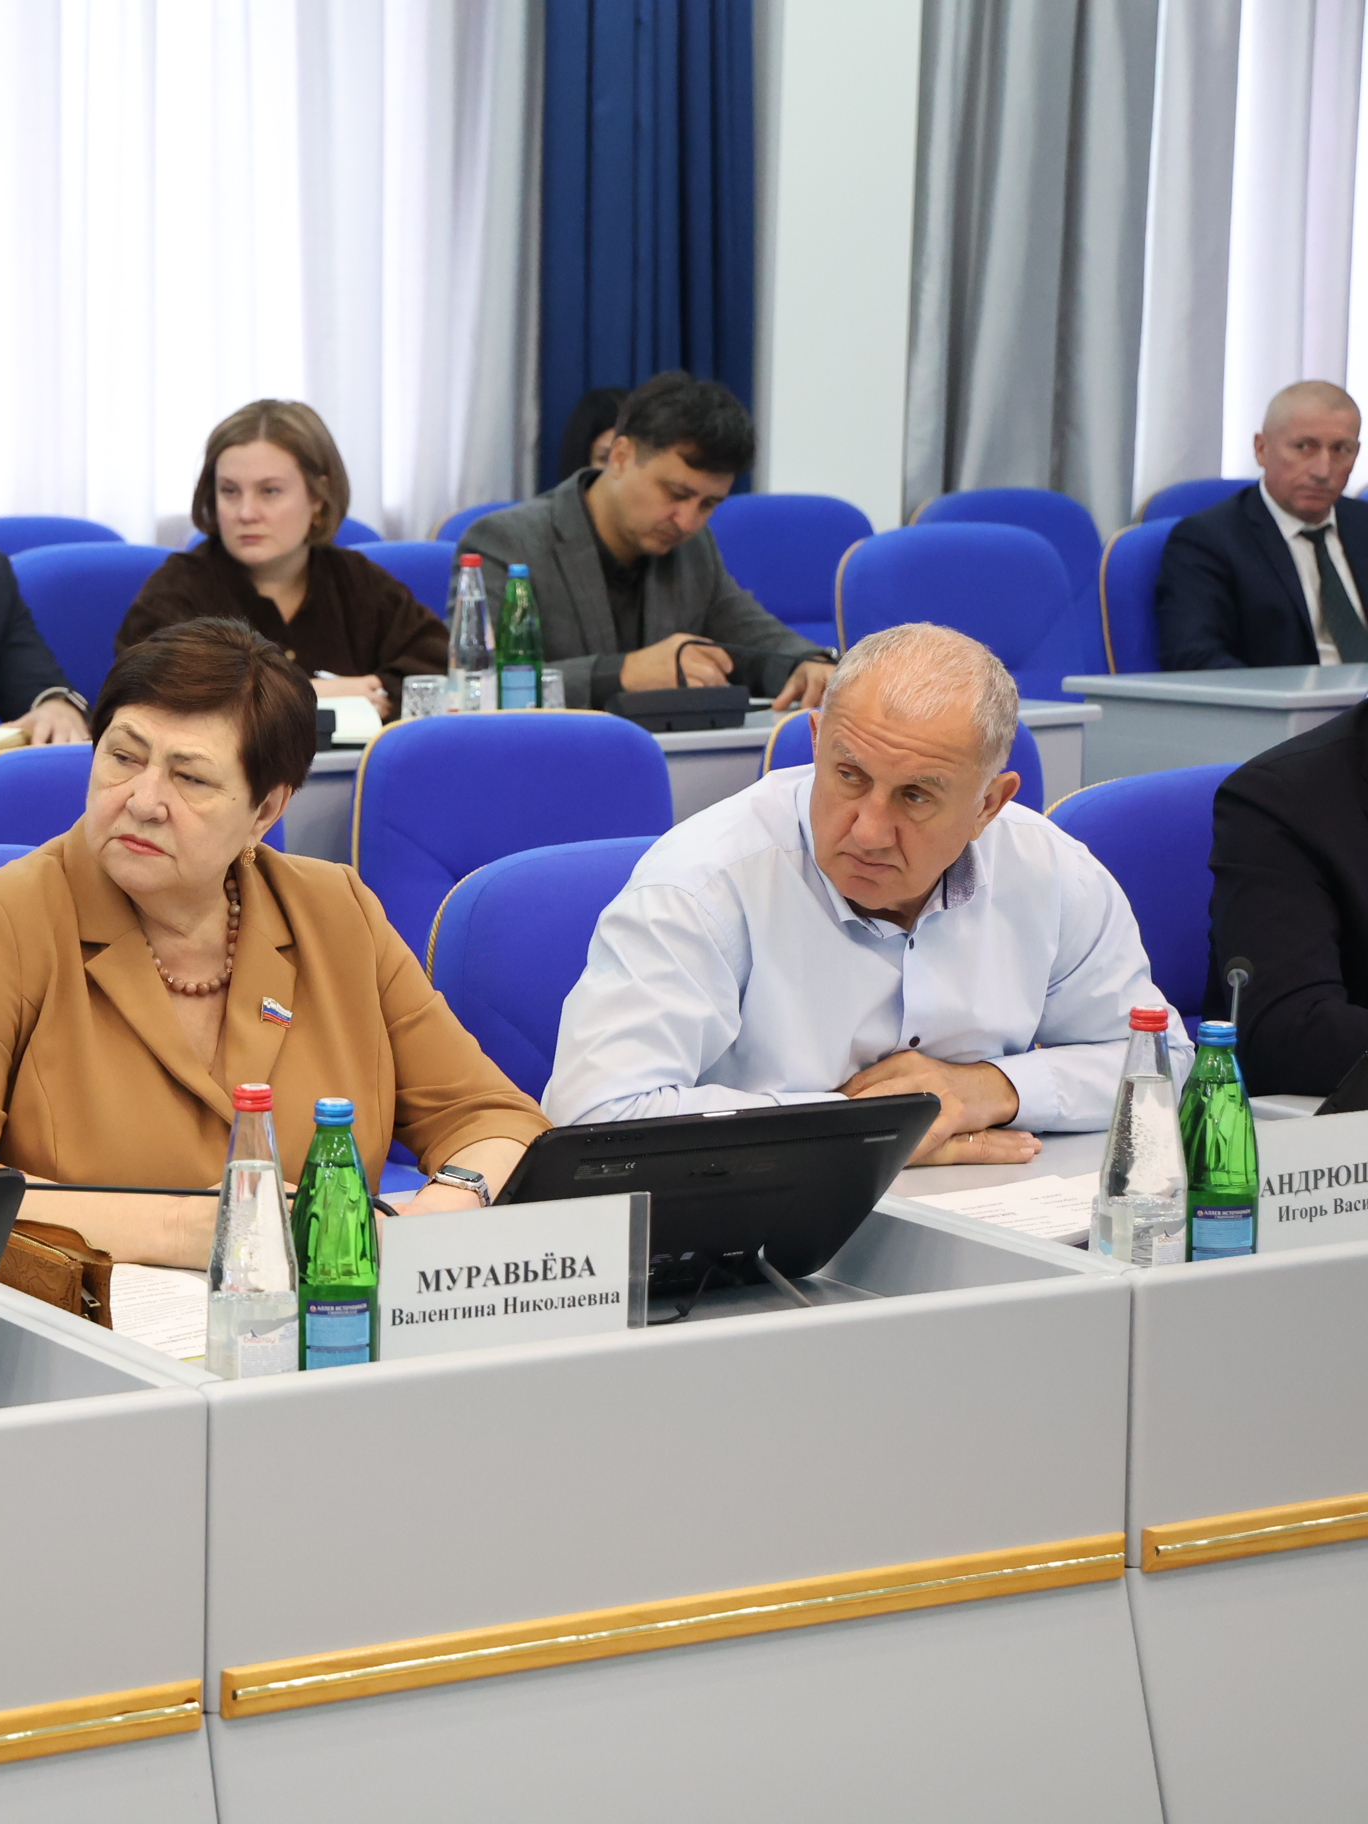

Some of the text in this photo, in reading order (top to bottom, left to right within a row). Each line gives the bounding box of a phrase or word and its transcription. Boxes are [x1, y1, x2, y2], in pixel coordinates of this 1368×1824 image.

[1278, 1205, 1328, 1223] Игорь
[416, 1252, 597, 1294] МУРАВЬЁВА
[390, 1290, 621, 1326] Валентина Николаевна
